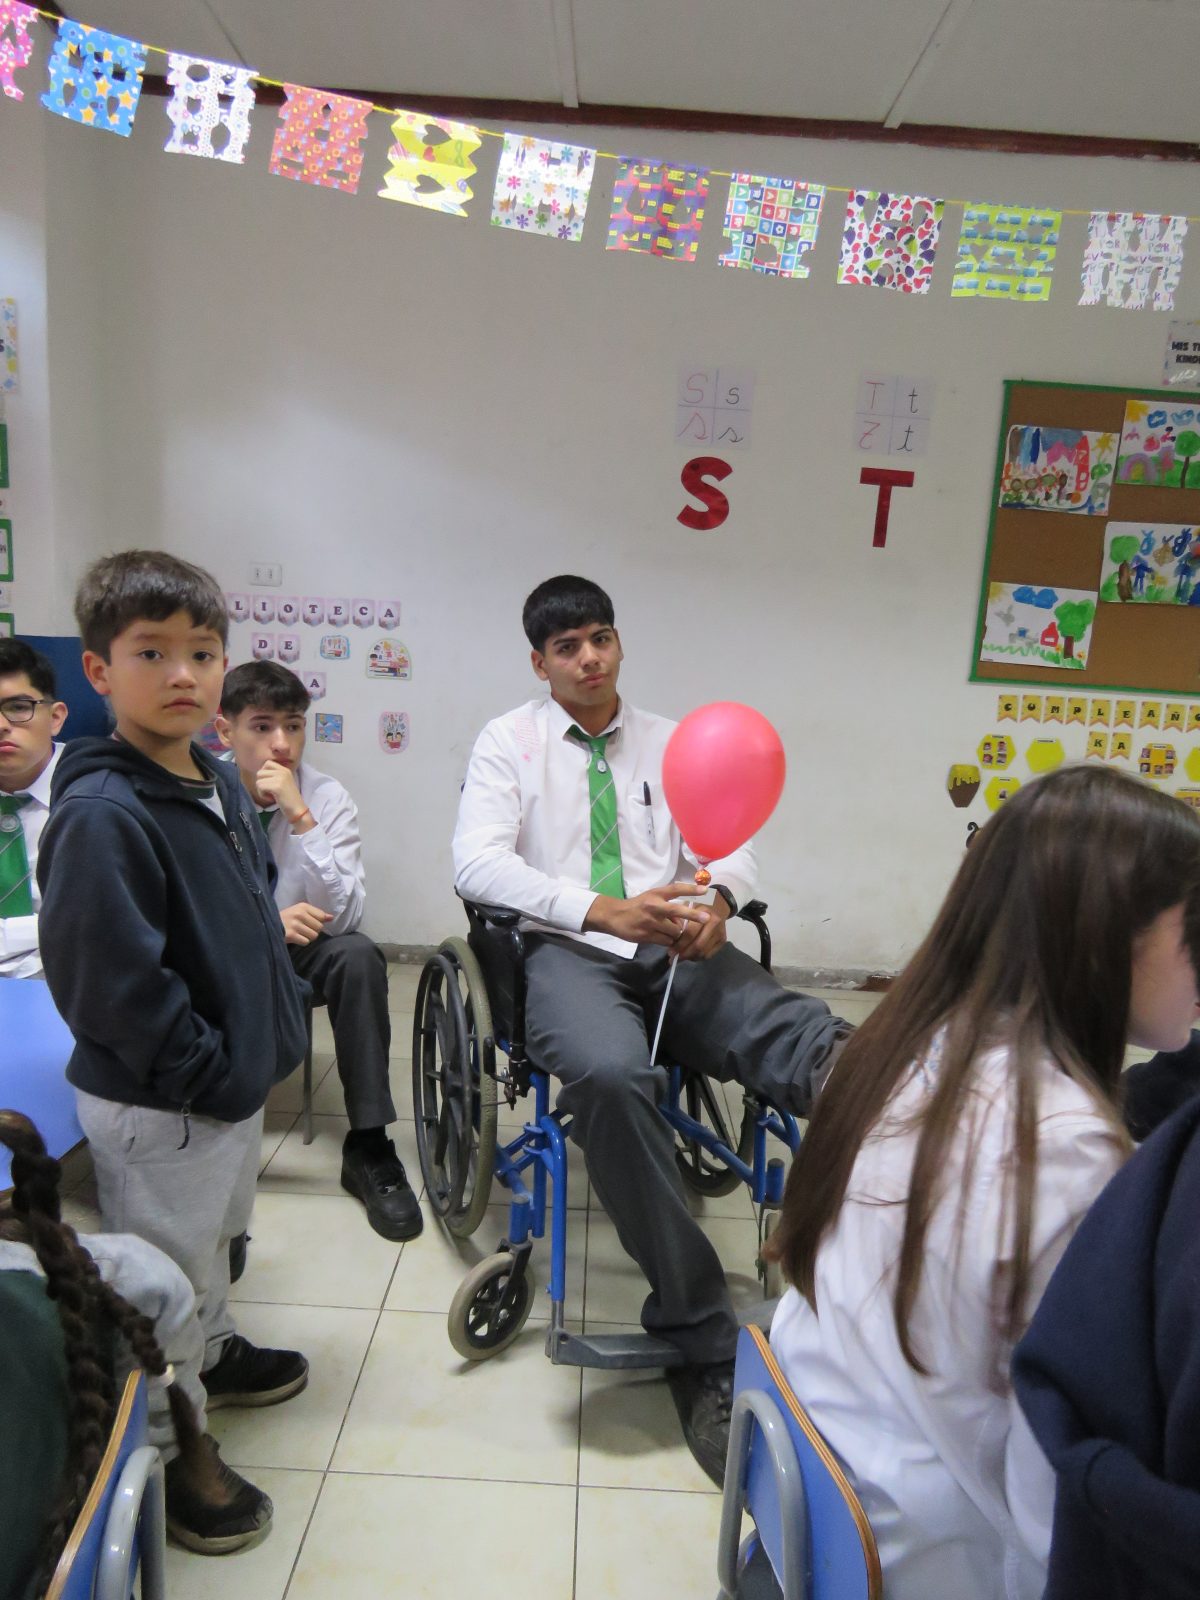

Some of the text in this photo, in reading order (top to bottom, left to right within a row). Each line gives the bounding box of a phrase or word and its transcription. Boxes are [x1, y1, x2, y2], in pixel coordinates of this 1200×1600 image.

[1175, 354, 1200, 364] KIND
[682, 373, 708, 403] S
[866, 381, 919, 413] T t
[677, 456, 733, 531] S
[860, 467, 915, 548] T
[258, 639, 293, 650] DE
